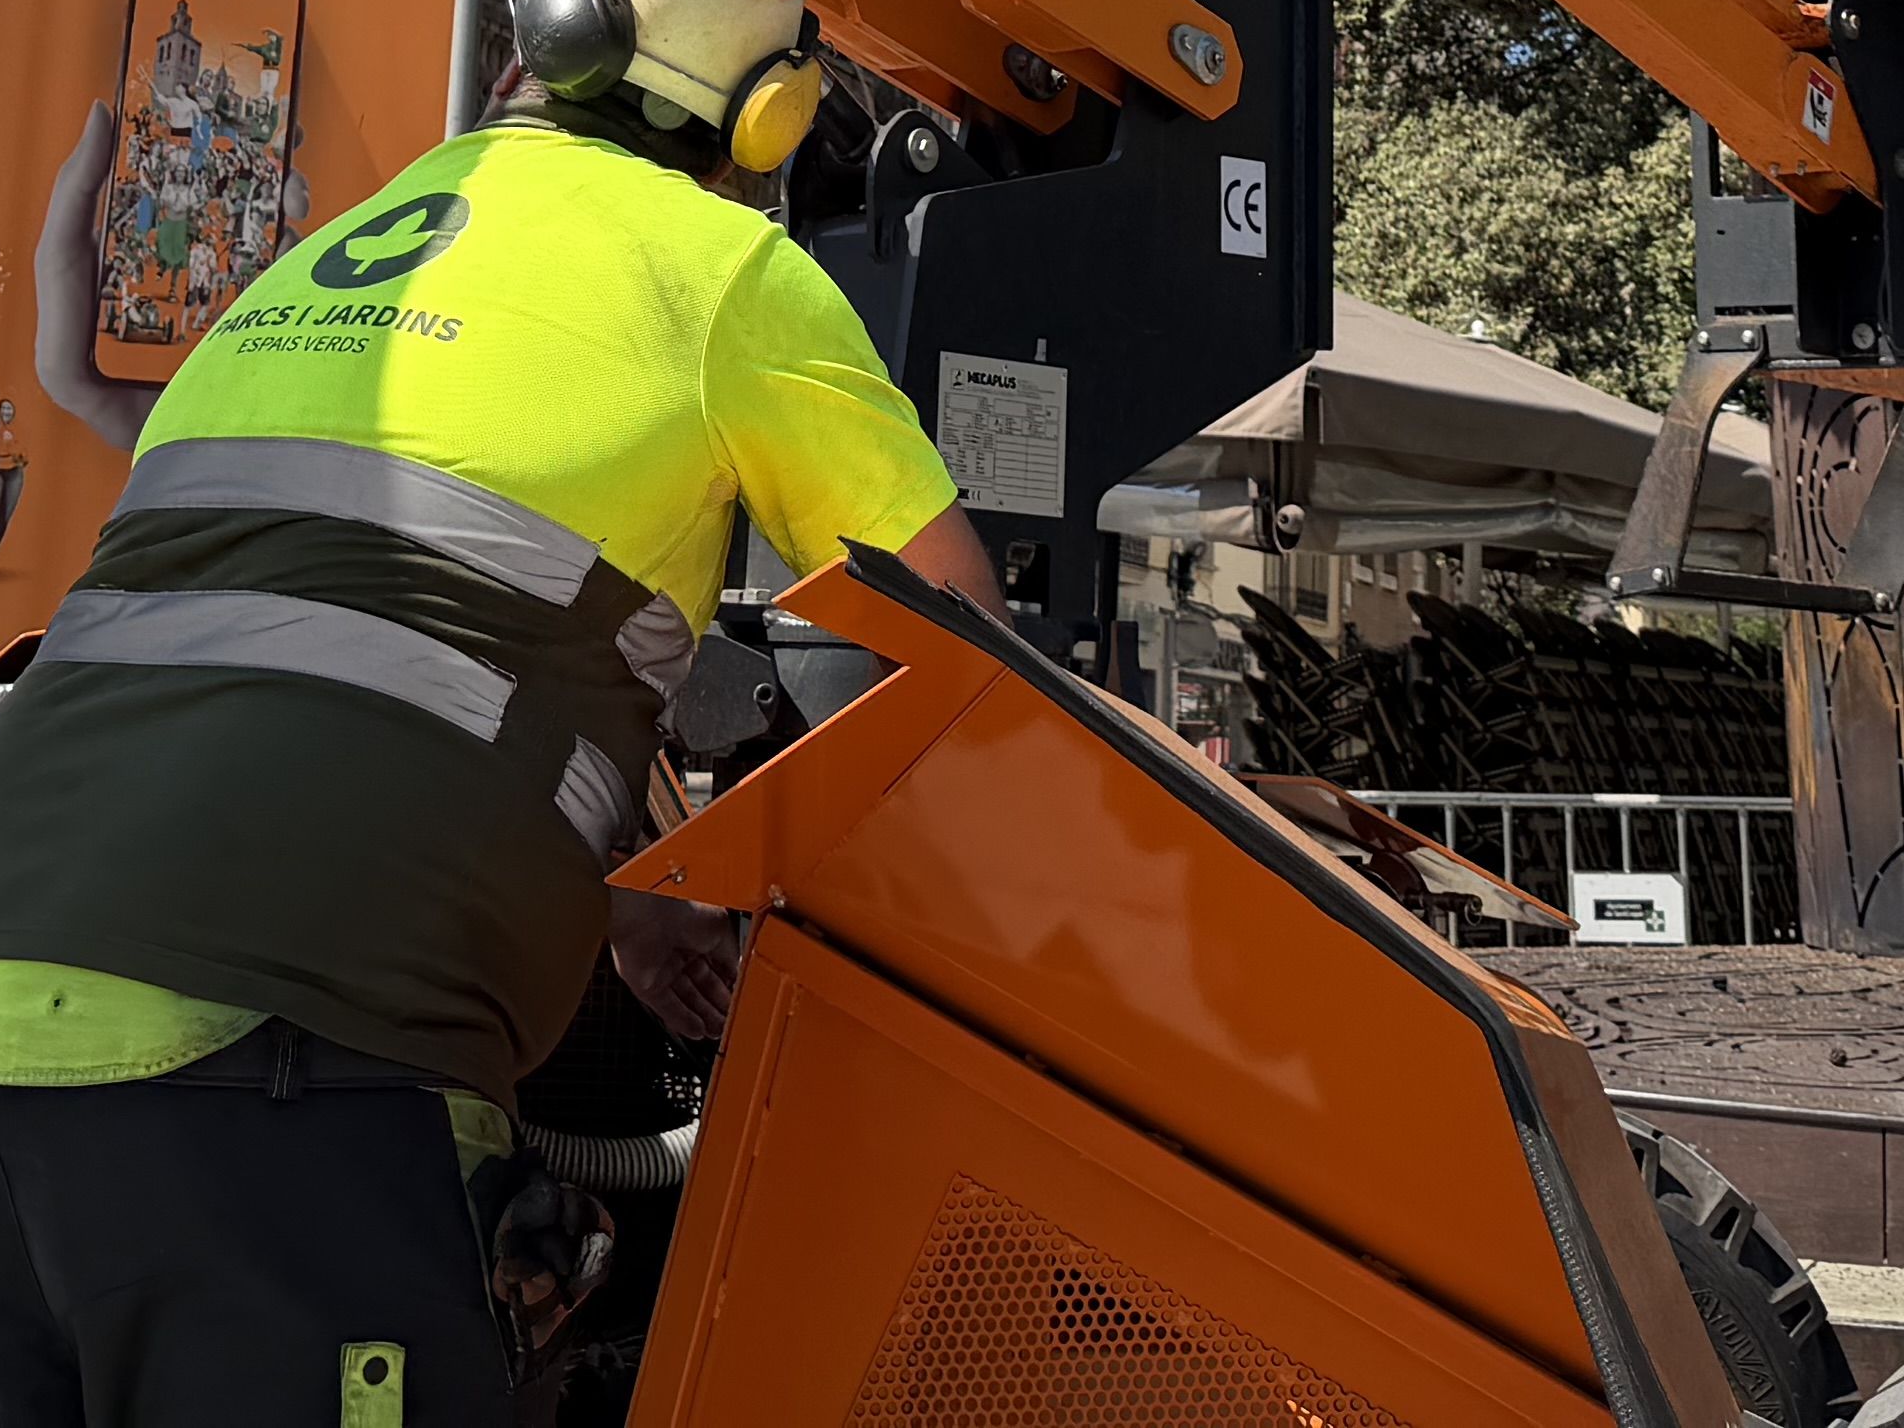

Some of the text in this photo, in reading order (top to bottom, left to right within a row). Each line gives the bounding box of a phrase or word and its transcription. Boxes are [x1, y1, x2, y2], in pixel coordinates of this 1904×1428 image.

[312, 304, 464, 342] JARDINS
[236, 335, 370, 355] ESPAIS VERDS
